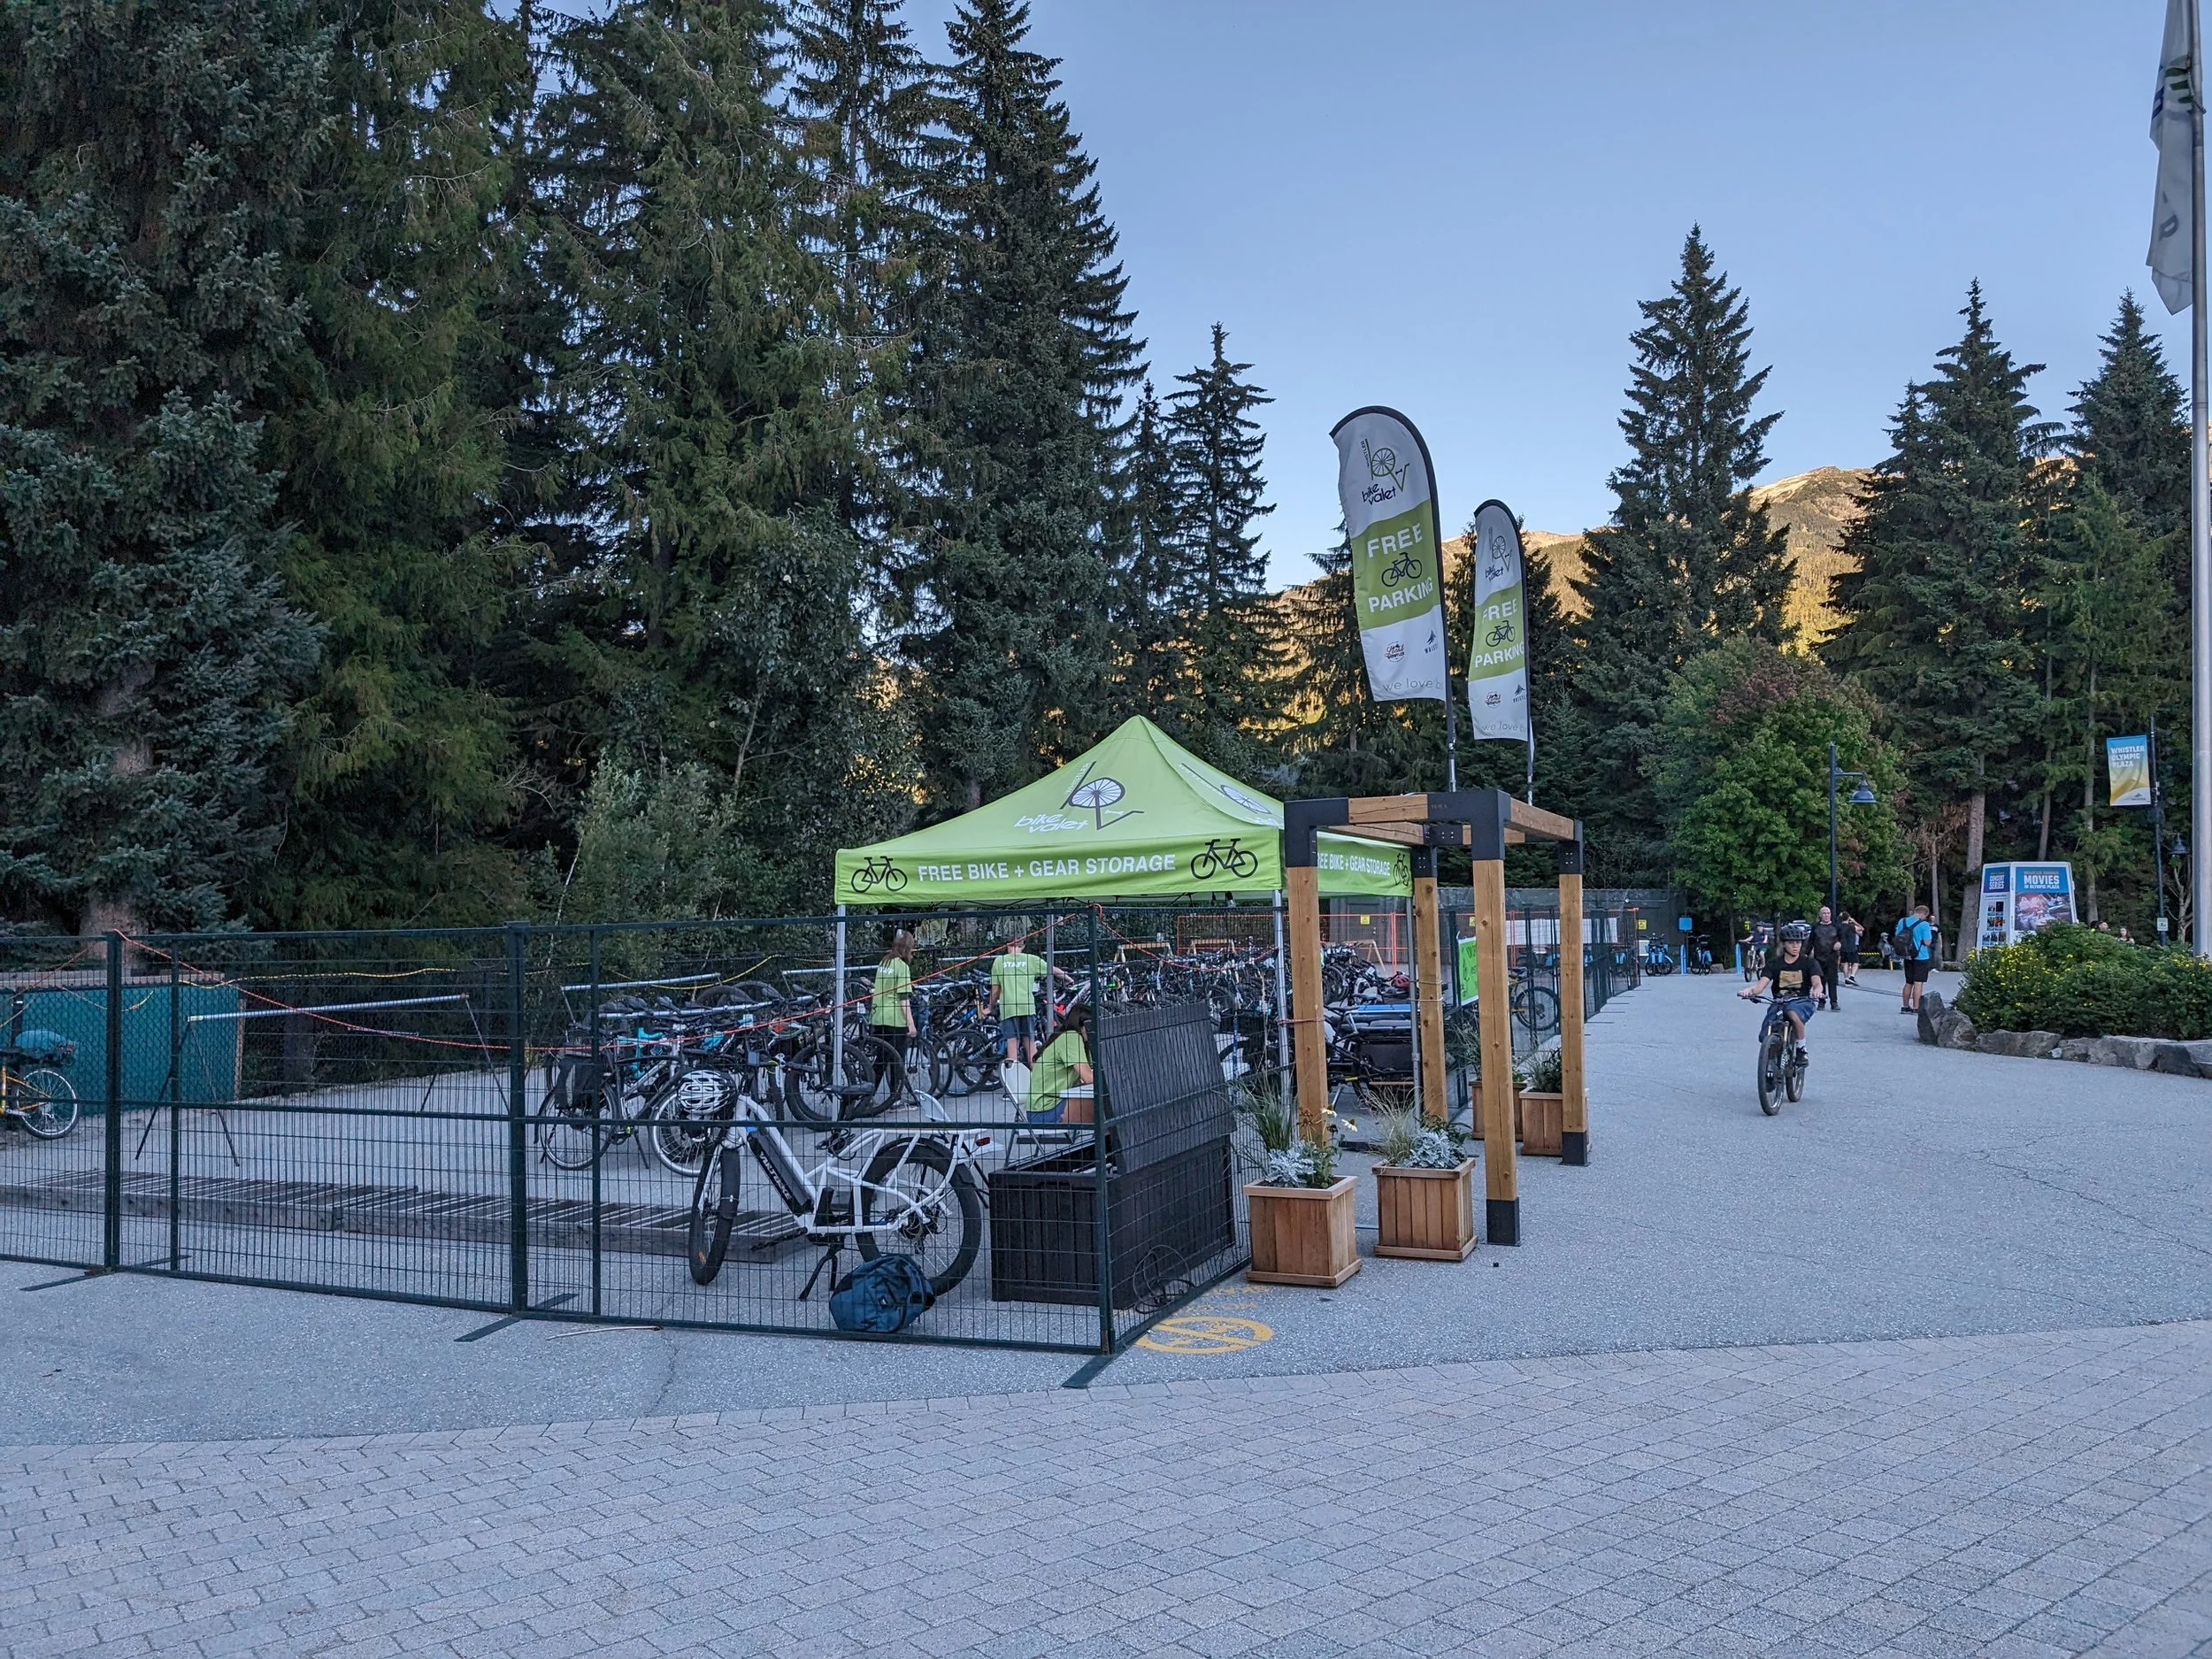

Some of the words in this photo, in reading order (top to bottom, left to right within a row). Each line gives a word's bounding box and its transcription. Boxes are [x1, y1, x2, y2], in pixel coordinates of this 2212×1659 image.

[1361, 482, 1380, 503] bike
[1368, 486, 1396, 505] valet
[1367, 523, 1423, 558] FREE
[1368, 576, 1433, 613] PARKING
[1474, 641, 1525, 668] PARKING
[1382, 682, 1402, 692] we
[1406, 678, 1433, 688] love
[1499, 721, 1518, 731] love
[2110, 745, 2145, 754] WHISTLER
[1014, 813, 1064, 827] bike
[1029, 818, 1089, 833] valet
[918, 864, 963, 882] FREE
[967, 862, 1010, 880] BIKE
[1029, 858, 1079, 878] GEAR
[1086, 854, 1176, 874] STORAGE
[1317, 852, 1328, 870] REE
[1329, 852, 1344, 871] BIKE
[1349, 855, 1366, 872] GEAR
[1366, 857, 1391, 876] STORAGE
[2024, 874, 2060, 885] MOVIES
